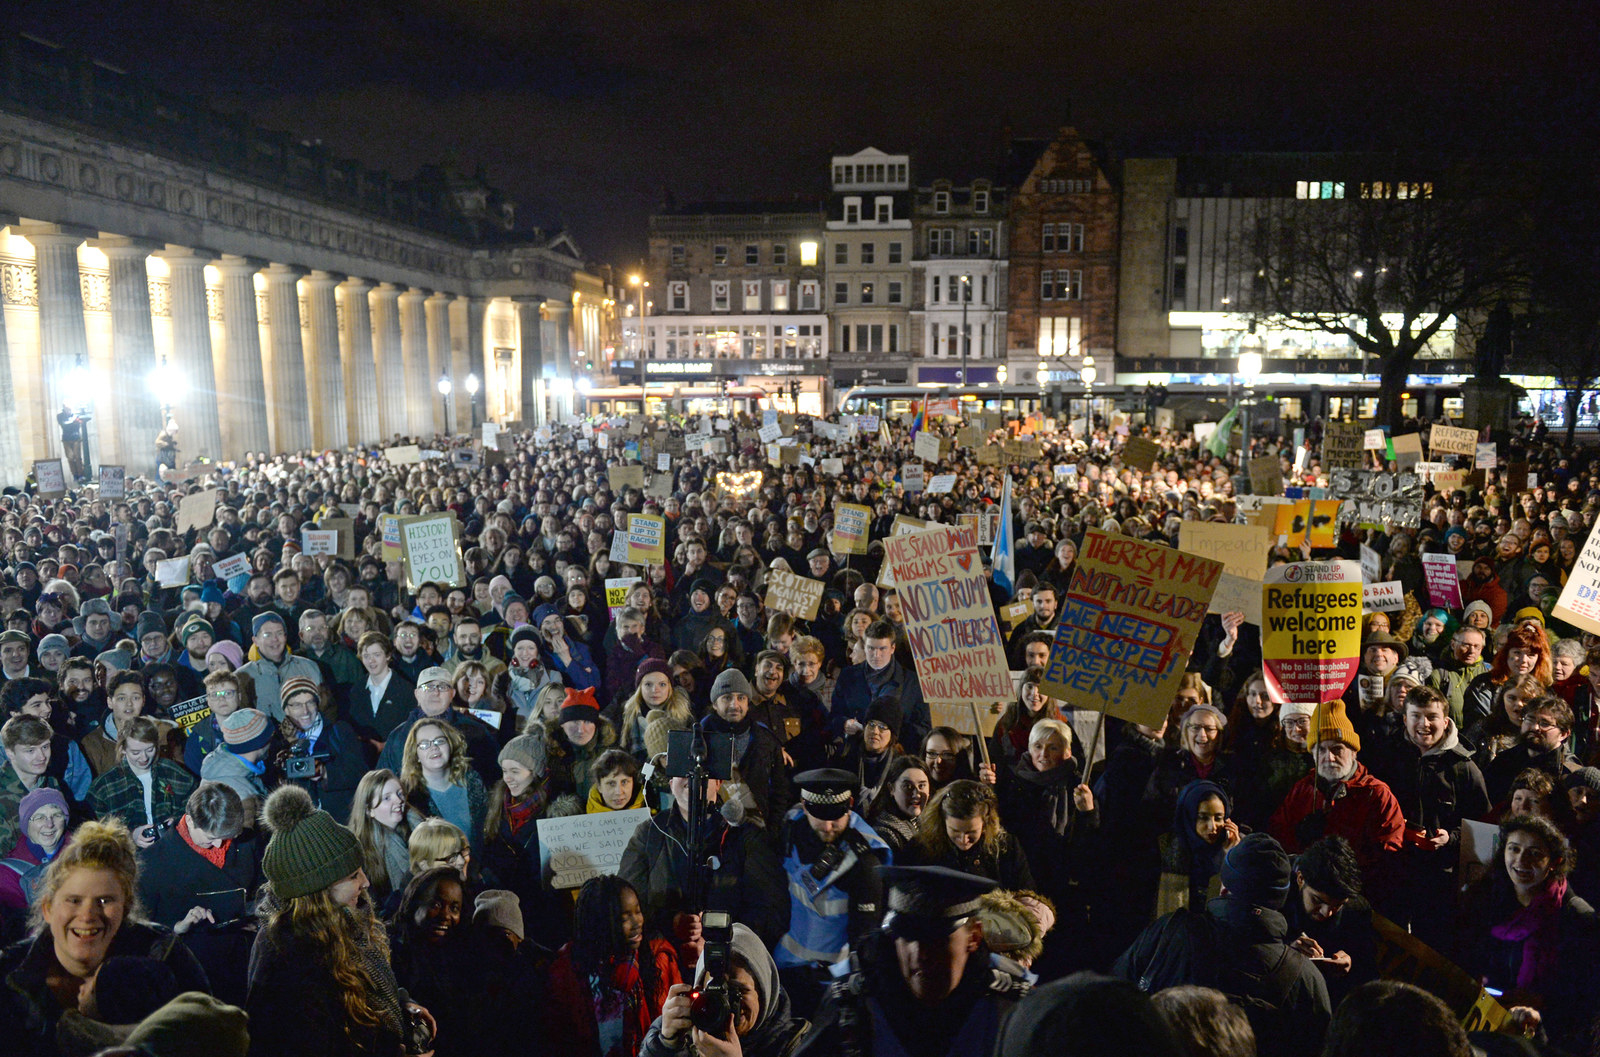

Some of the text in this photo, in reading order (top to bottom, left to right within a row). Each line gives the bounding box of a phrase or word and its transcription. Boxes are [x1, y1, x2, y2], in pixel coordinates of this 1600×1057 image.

[1296, 361, 1350, 372] HOM
[1434, 427, 1475, 441] REFUGEES
[1332, 436, 1360, 449] TRUMP
[1434, 439, 1474, 451] WELCOME
[1326, 450, 1362, 459] means
[1438, 473, 1459, 481] FAKE
[1337, 471, 1416, 499] STOP
[841, 507, 865, 518] STAND
[634, 518, 659, 528] STAND
[836, 524, 863, 535] RACISM
[408, 522, 448, 540] HISTORY
[411, 537, 448, 552] HAS ITS
[630, 535, 658, 545] RACISM
[1188, 529, 1265, 558] Impeach
[886, 538, 911, 564] WE
[909, 531, 949, 559] STAND
[218, 557, 242, 569] Shame
[412, 550, 452, 566] EYES ON
[1086, 532, 1220, 588] THERESA MAY
[417, 563, 454, 582] YOU
[1304, 564, 1341, 573] STAND UP
[1435, 571, 1456, 579] workers
[1305, 573, 1345, 581] TO RACISM
[1433, 577, 1456, 586] students
[608, 588, 628, 597] NO T
[1070, 565, 1121, 601] NOT
[1110, 582, 1147, 606] MY
[1362, 585, 1394, 597] O BAN
[610, 597, 625, 605] RAC
[769, 584, 818, 607] AGAINST
[898, 576, 988, 626] NO TO TRUMP
[1268, 587, 1358, 614] Refugees
[775, 599, 809, 618] HATE
[1371, 598, 1400, 608] WALL
[1060, 601, 1173, 647] WE NEED
[1269, 611, 1356, 632] welcome
[907, 615, 1002, 660] NO TO THERESA
[1292, 634, 1337, 655] here
[923, 653, 961, 677] STAND
[1050, 642, 1161, 688] MORE THAN
[1281, 662, 1350, 673] No to Islamophobia
[1281, 671, 1347, 680] and anti-Semitism
[968, 669, 1017, 698] ANGELA
[1281, 683, 1299, 692] Stop
[1282, 691, 1316, 700] migrants
[181, 709, 210, 725] BLAC
[542, 816, 640, 832] FIRST THEY CAME FOR
[545, 828, 624, 843] THE MUSLIMS
[549, 839, 624, 854] AND WE SAID
[553, 853, 624, 867] NOT TOD
